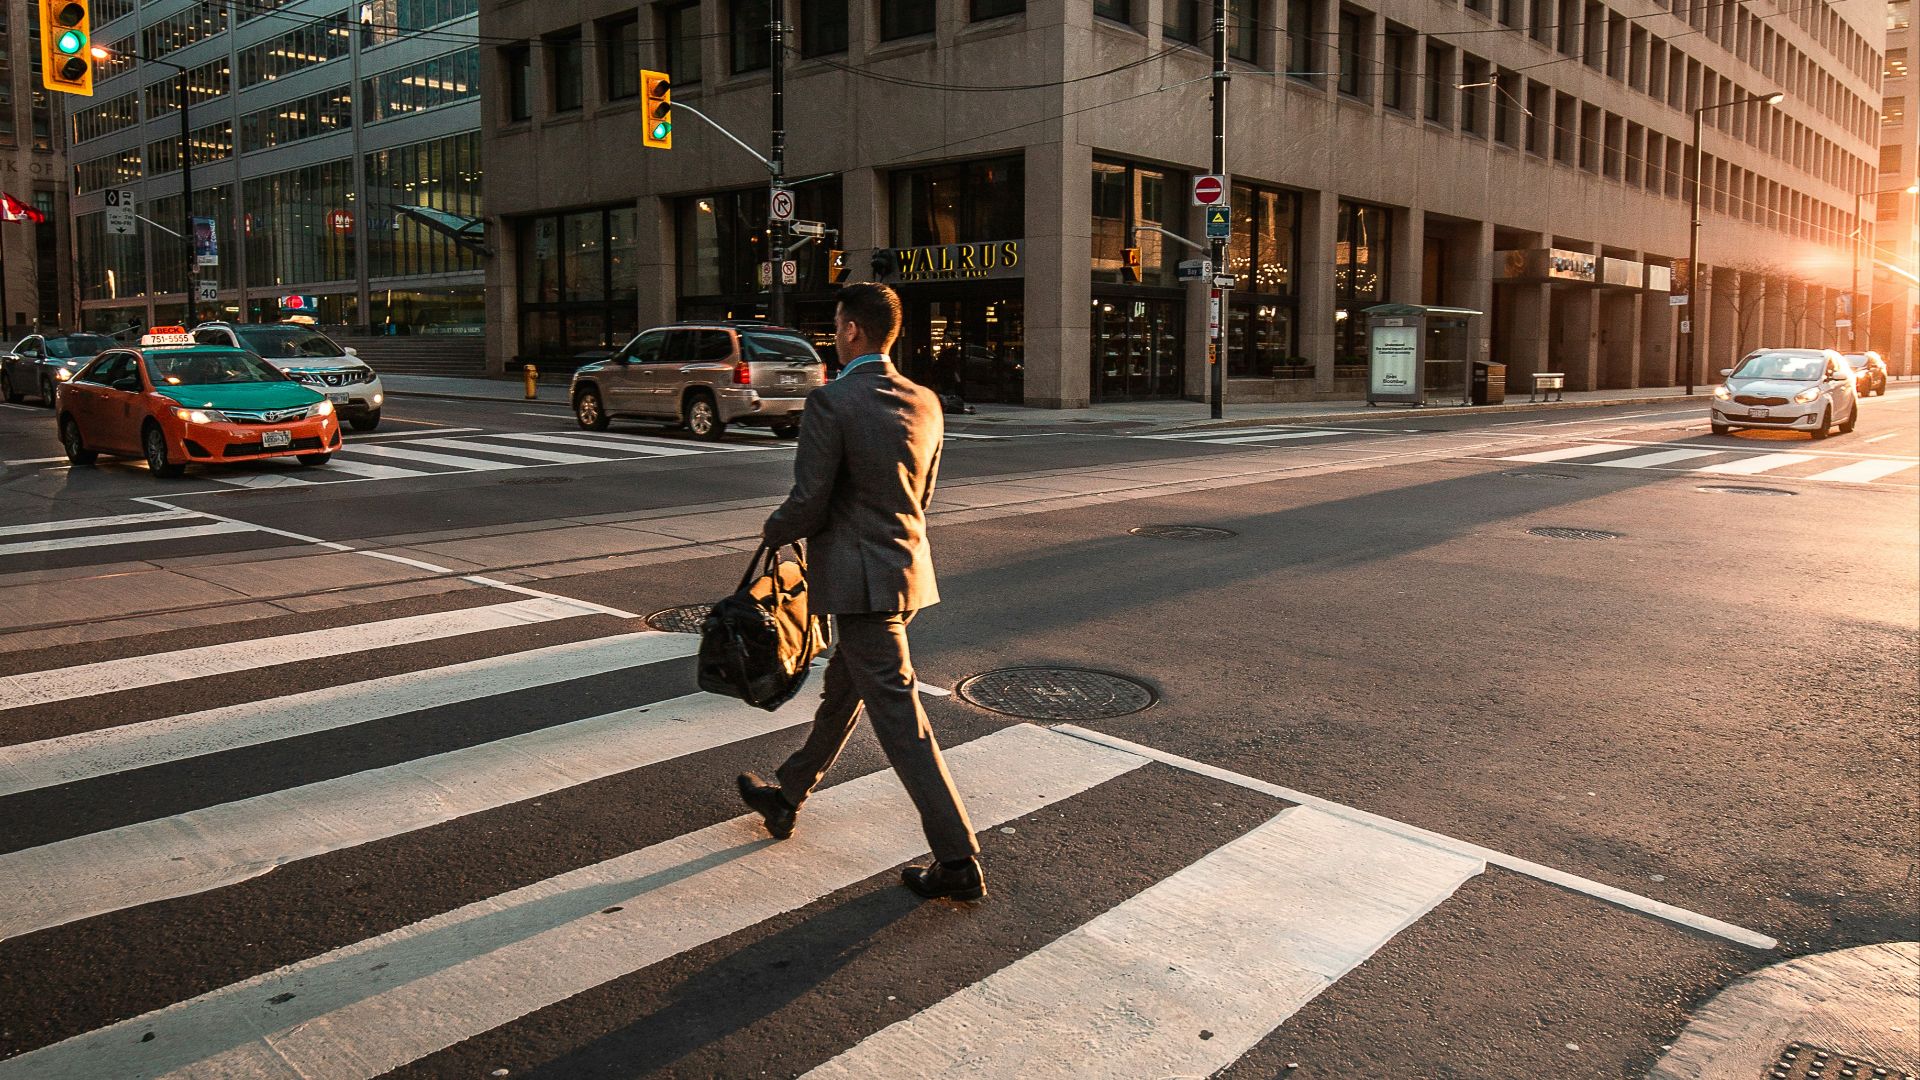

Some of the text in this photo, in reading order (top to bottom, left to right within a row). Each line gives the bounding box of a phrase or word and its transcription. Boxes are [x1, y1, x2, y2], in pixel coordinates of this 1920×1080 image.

[30, 162, 54, 175] OF
[896, 241, 1018, 273] WALRUS
[1187, 268, 1198, 277] Bay
[201, 288, 217, 299] 40
[151, 334, 189, 343] 751-5555
